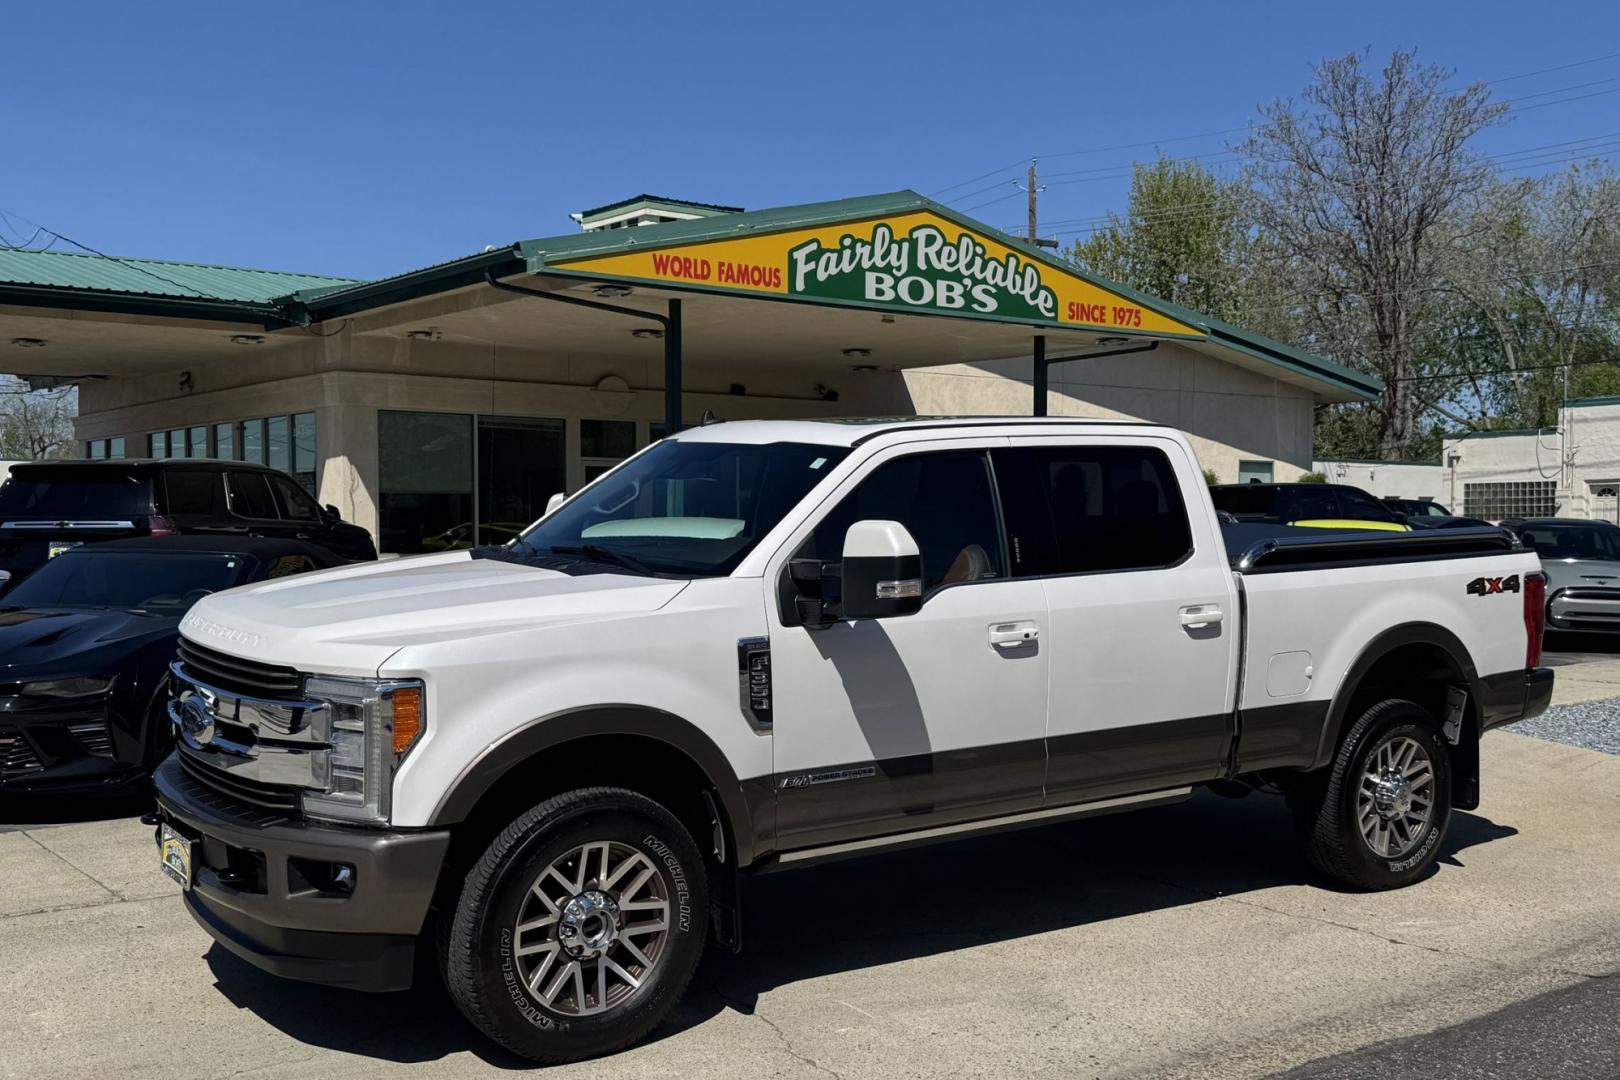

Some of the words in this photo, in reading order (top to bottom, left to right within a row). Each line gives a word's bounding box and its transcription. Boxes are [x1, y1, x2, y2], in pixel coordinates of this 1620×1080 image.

[652, 253, 711, 280] WORLD
[717, 261, 782, 288] FAMOUS
[792, 226, 909, 292] Fairly
[912, 227, 1056, 317] Reliable
[864, 271, 999, 313] BOB'S
[1068, 301, 1106, 323] SINCE
[1112, 306, 1141, 327] 1975
[1390, 826, 1439, 872] MICHELIN
[643, 835, 690, 932] MICHELIN
[501, 928, 551, 1029] MICHELIN
